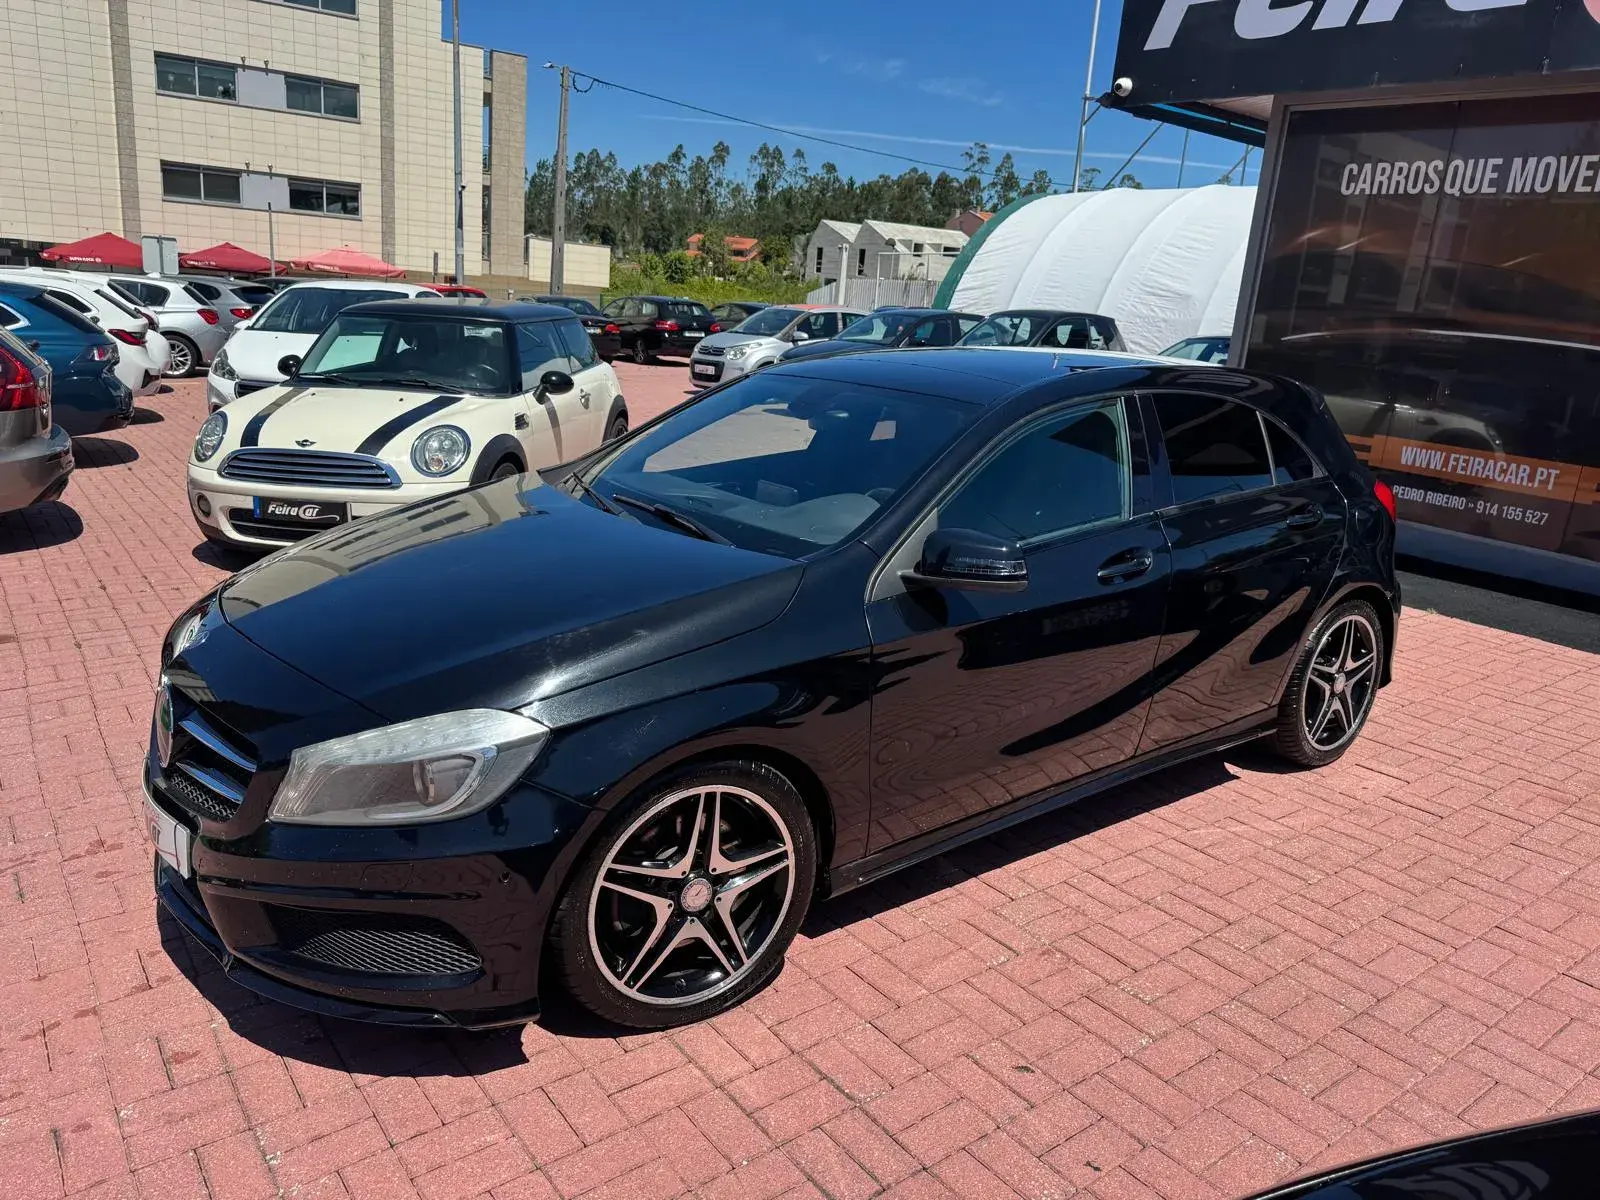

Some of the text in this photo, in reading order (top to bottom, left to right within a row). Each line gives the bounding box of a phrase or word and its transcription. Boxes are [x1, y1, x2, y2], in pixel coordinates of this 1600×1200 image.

[1340, 160, 1443, 196] CARROS
[1443, 158, 1504, 197] QUE
[1401, 446, 1560, 491] WWW.FEIRACAR.PT
[1393, 484, 1425, 503] PEDRO
[1425, 491, 1466, 511] RIBEIRO
[1476, 501, 1498, 517] 914
[1501, 507, 1522, 522] 155
[1524, 511, 1549, 526] 527
